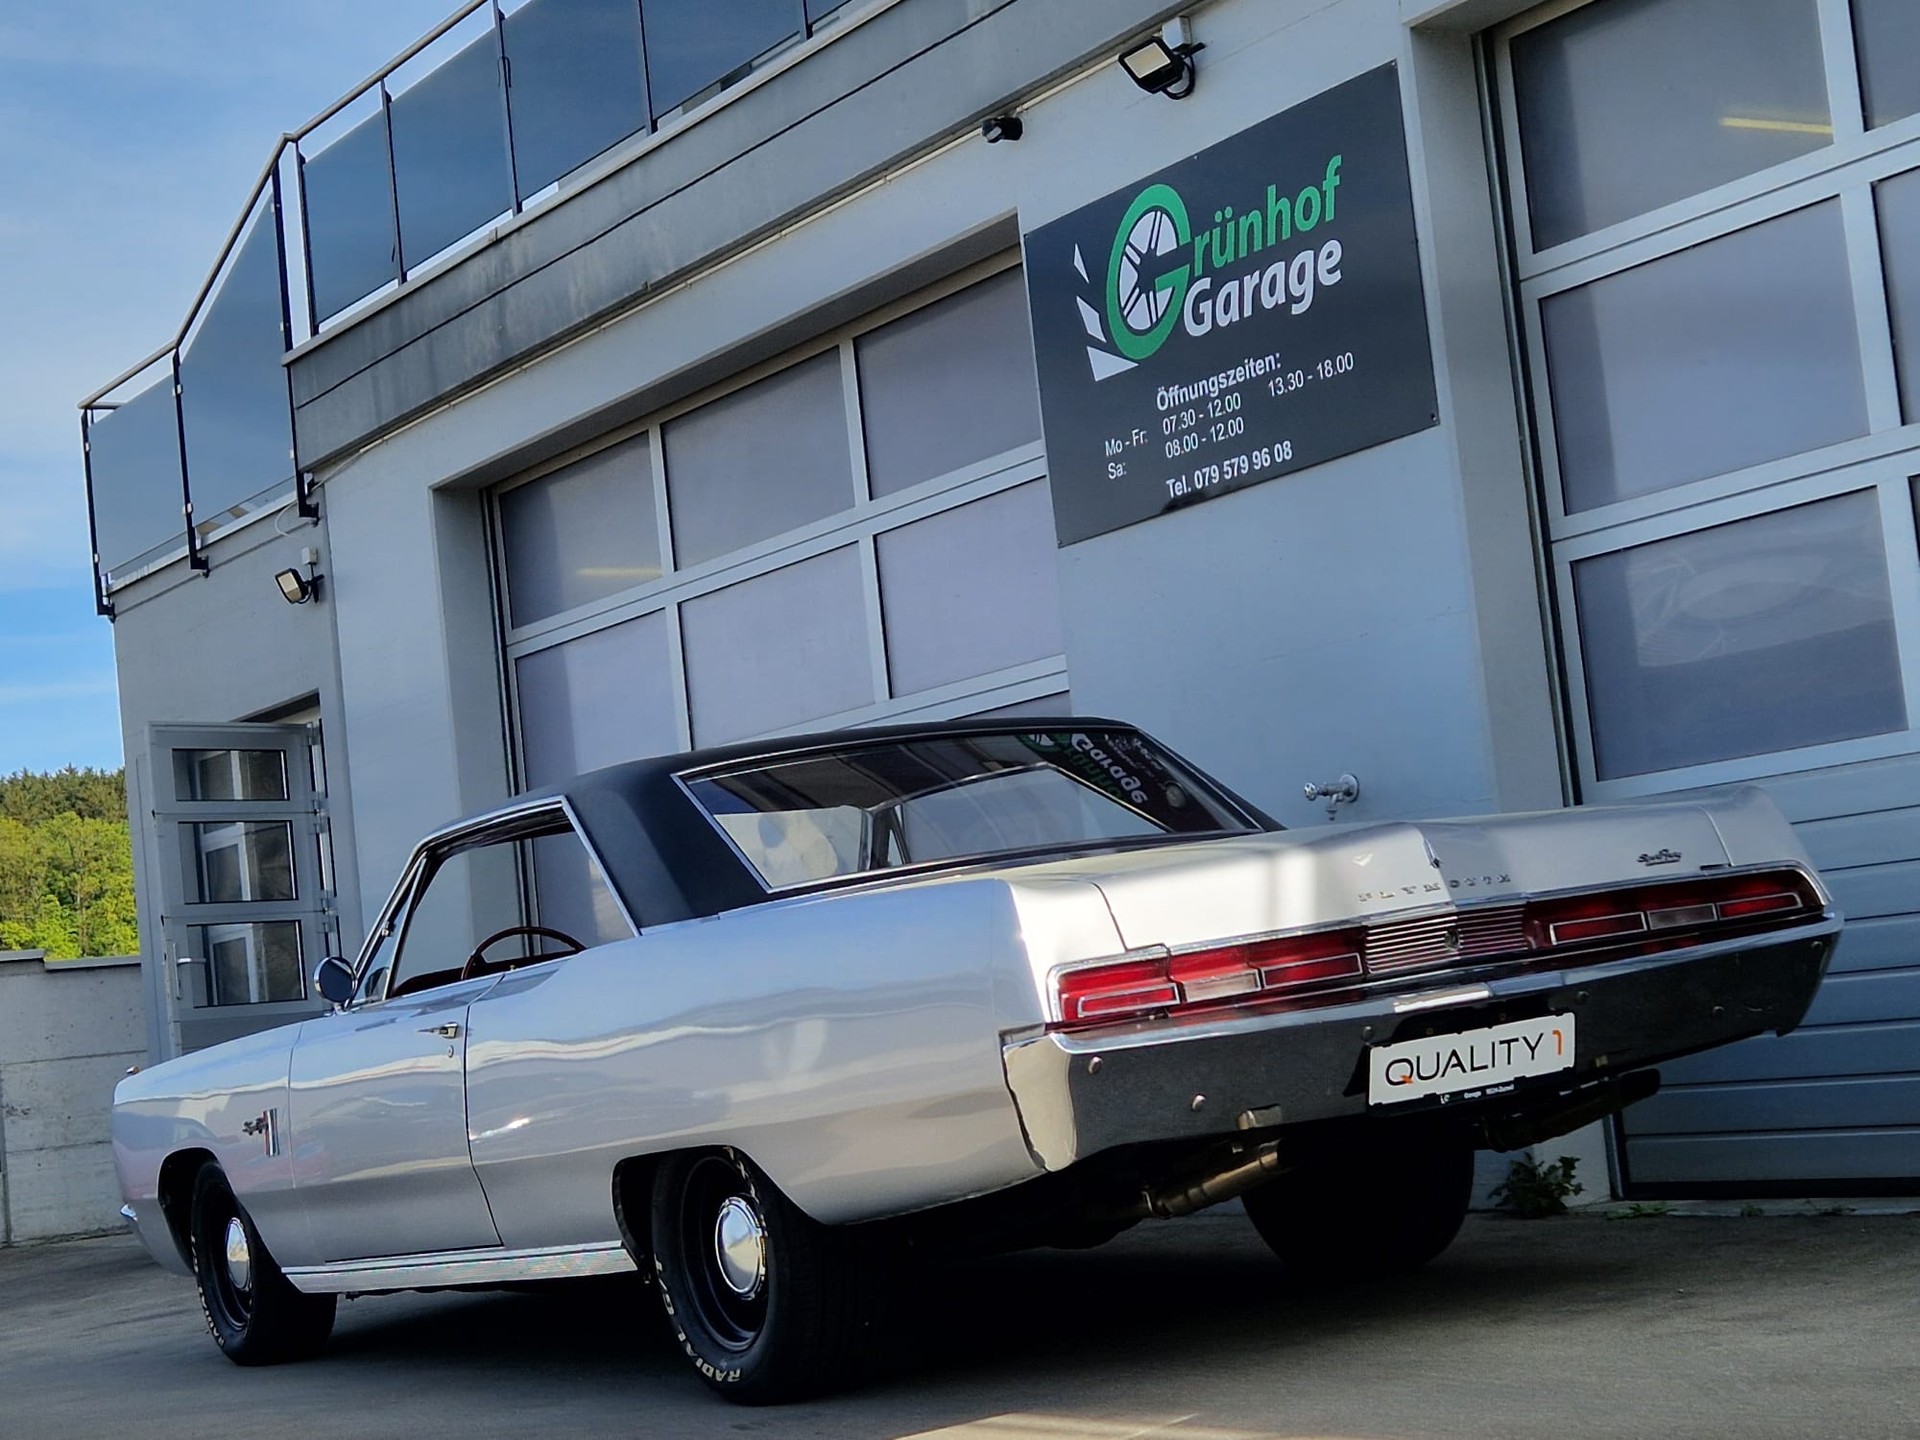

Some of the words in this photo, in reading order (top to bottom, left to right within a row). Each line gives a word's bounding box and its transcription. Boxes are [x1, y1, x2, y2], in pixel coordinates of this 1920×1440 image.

[1106, 154, 1342, 360] Grünhof
[1183, 239, 1343, 337] Garage
[1105, 438, 1123, 457] Mo
[1162, 408, 1196, 436] 07.30
[1207, 392, 1242, 419] 12.00
[1268, 370, 1304, 397] 13.30
[1316, 352, 1354, 381] 18.00
[1156, 352, 1282, 411] Öffnungszeiten:
[1107, 461, 1127, 480] Sa:
[1165, 433, 1199, 459] 08.00
[1210, 416, 1244, 443] 12.00
[1166, 477, 1192, 498] Tel.
[1194, 463, 1220, 489] 079
[1223, 456, 1249, 481] 579
[1252, 447, 1271, 470] 96
[1274, 440, 1293, 463] 08
[1385, 1032, 1545, 1087] QUALITY
[1551, 1028, 1564, 1057] 1
[677, 1324, 742, 1383] RADIAL
